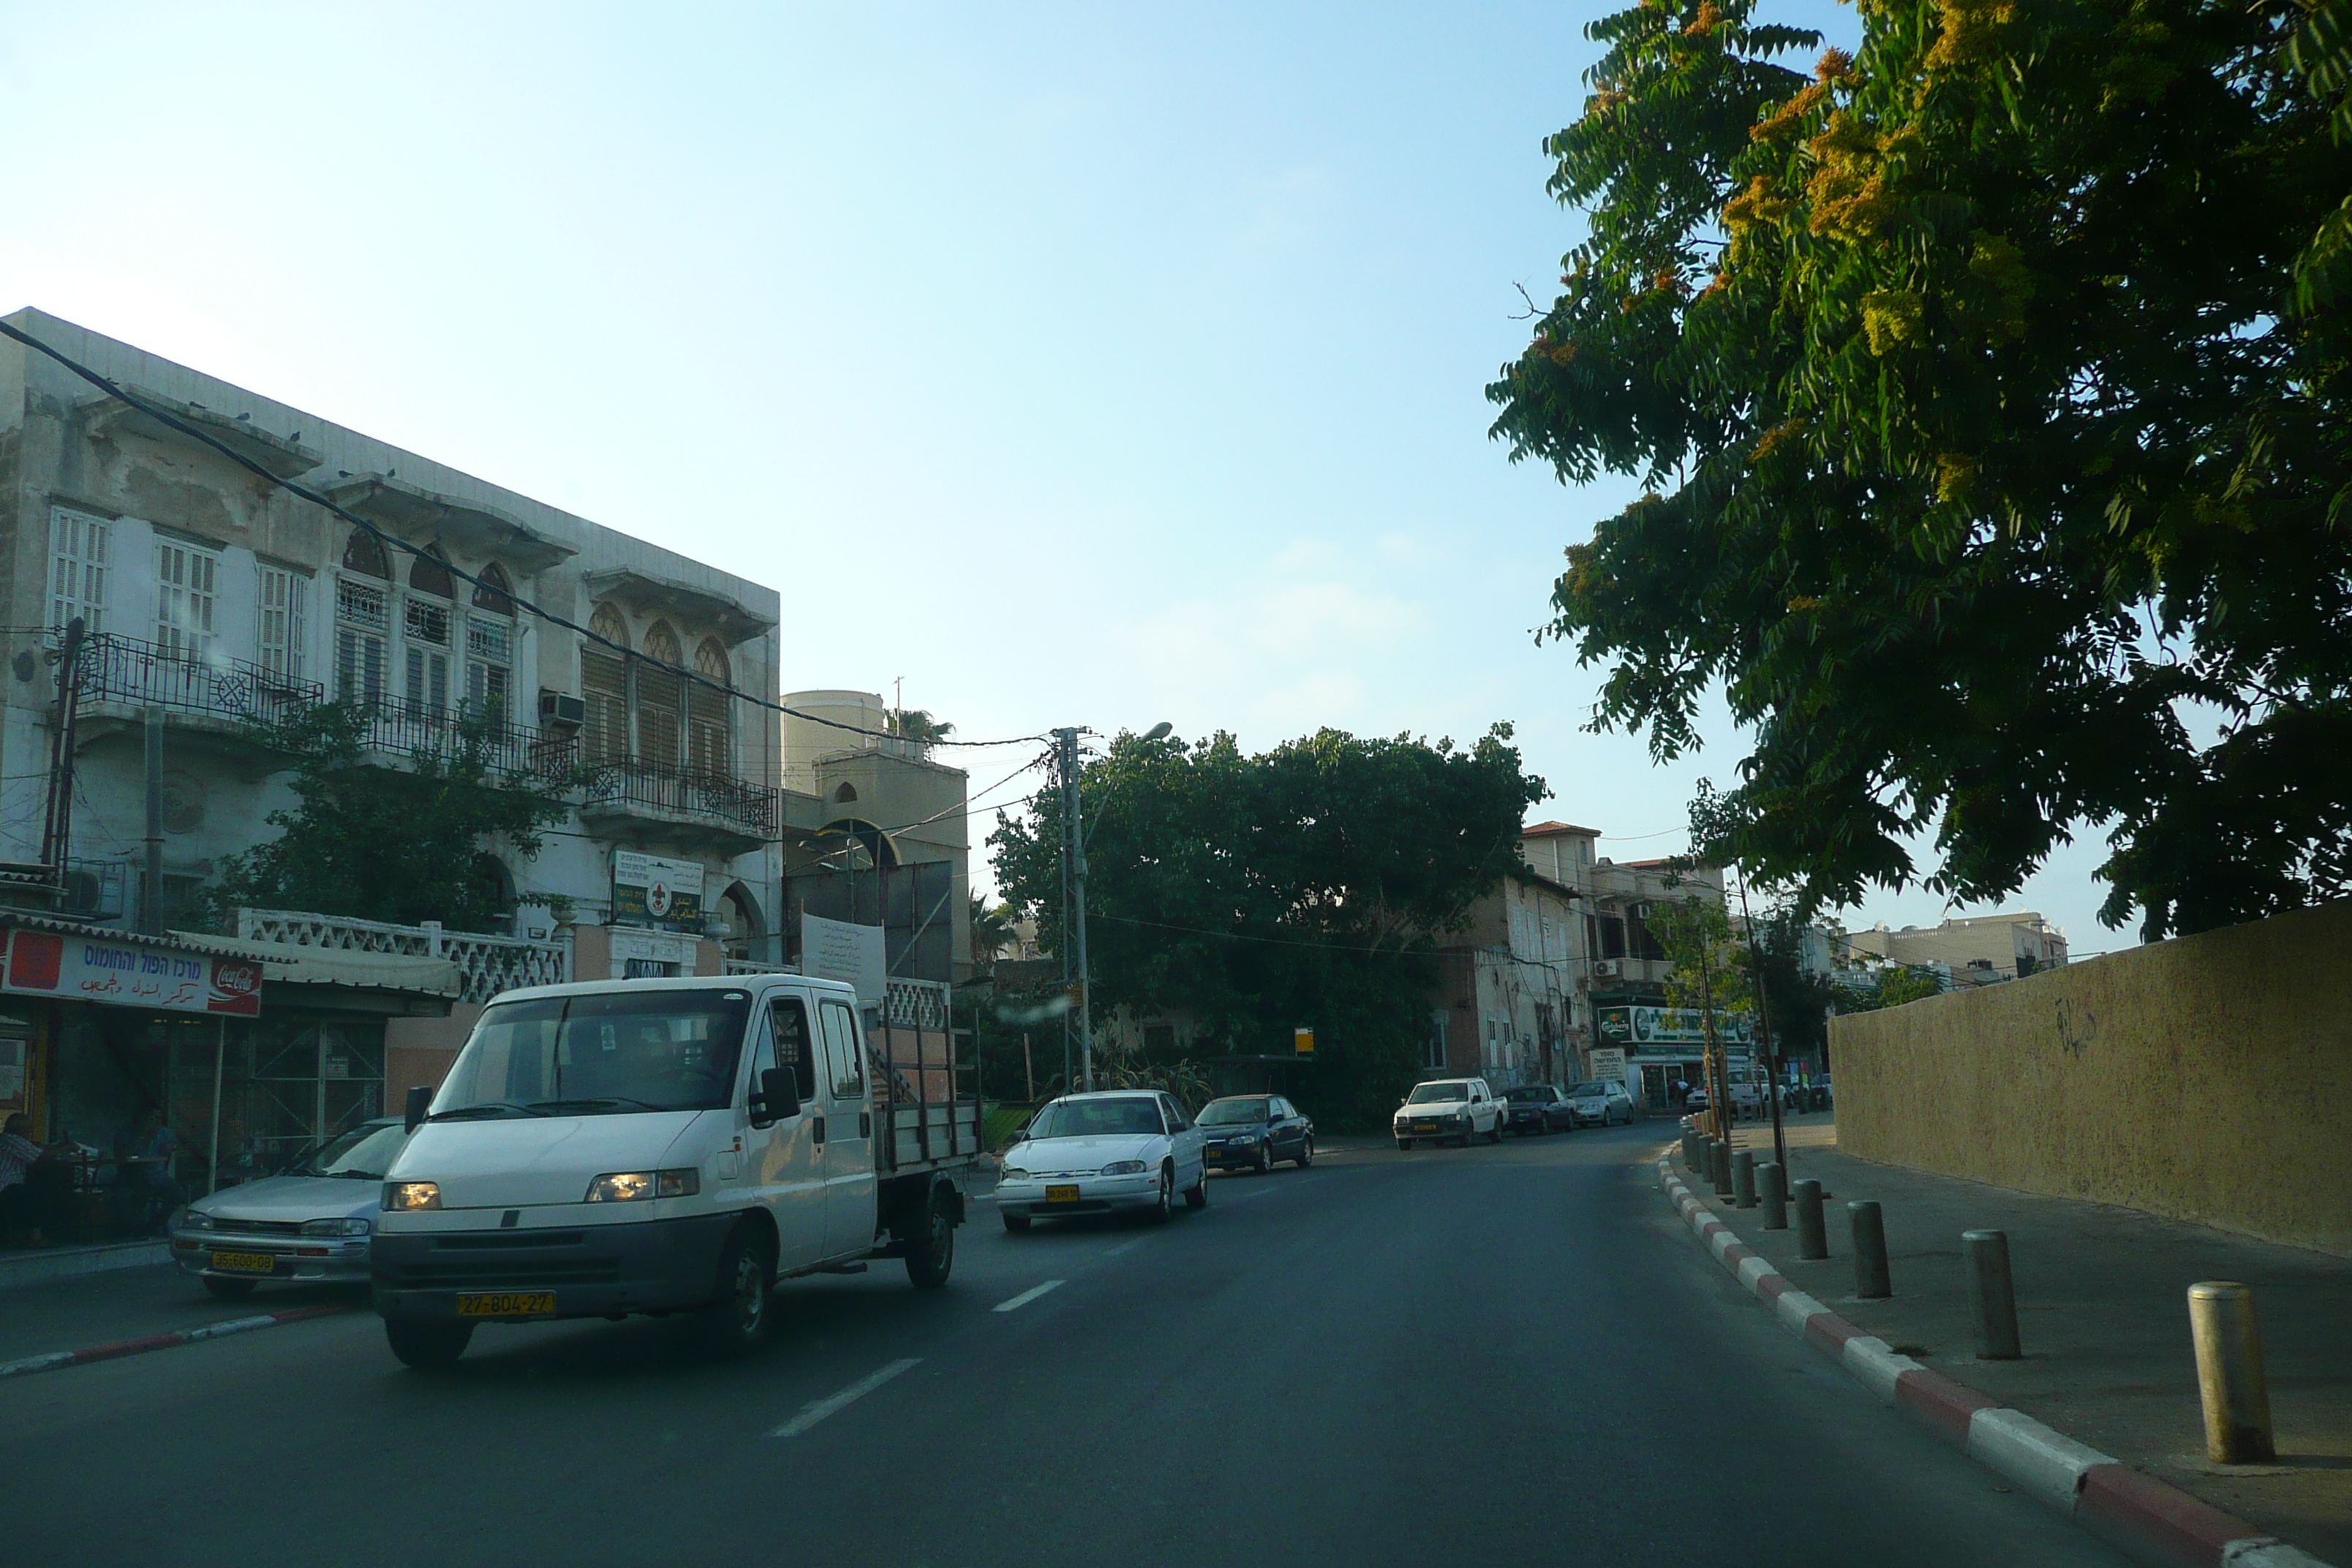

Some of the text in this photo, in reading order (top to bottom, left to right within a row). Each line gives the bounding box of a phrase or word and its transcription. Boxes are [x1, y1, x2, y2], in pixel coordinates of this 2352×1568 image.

[85, 944, 135, 971] והחומוס
[141, 948, 168, 976] הפול
[173, 958, 200, 980] מרכז
[162, 983, 198, 1005] مركز
[1601, 1021, 1629, 1032] Carlsberg
[464, 1294, 547, 1313] 27-804-27
